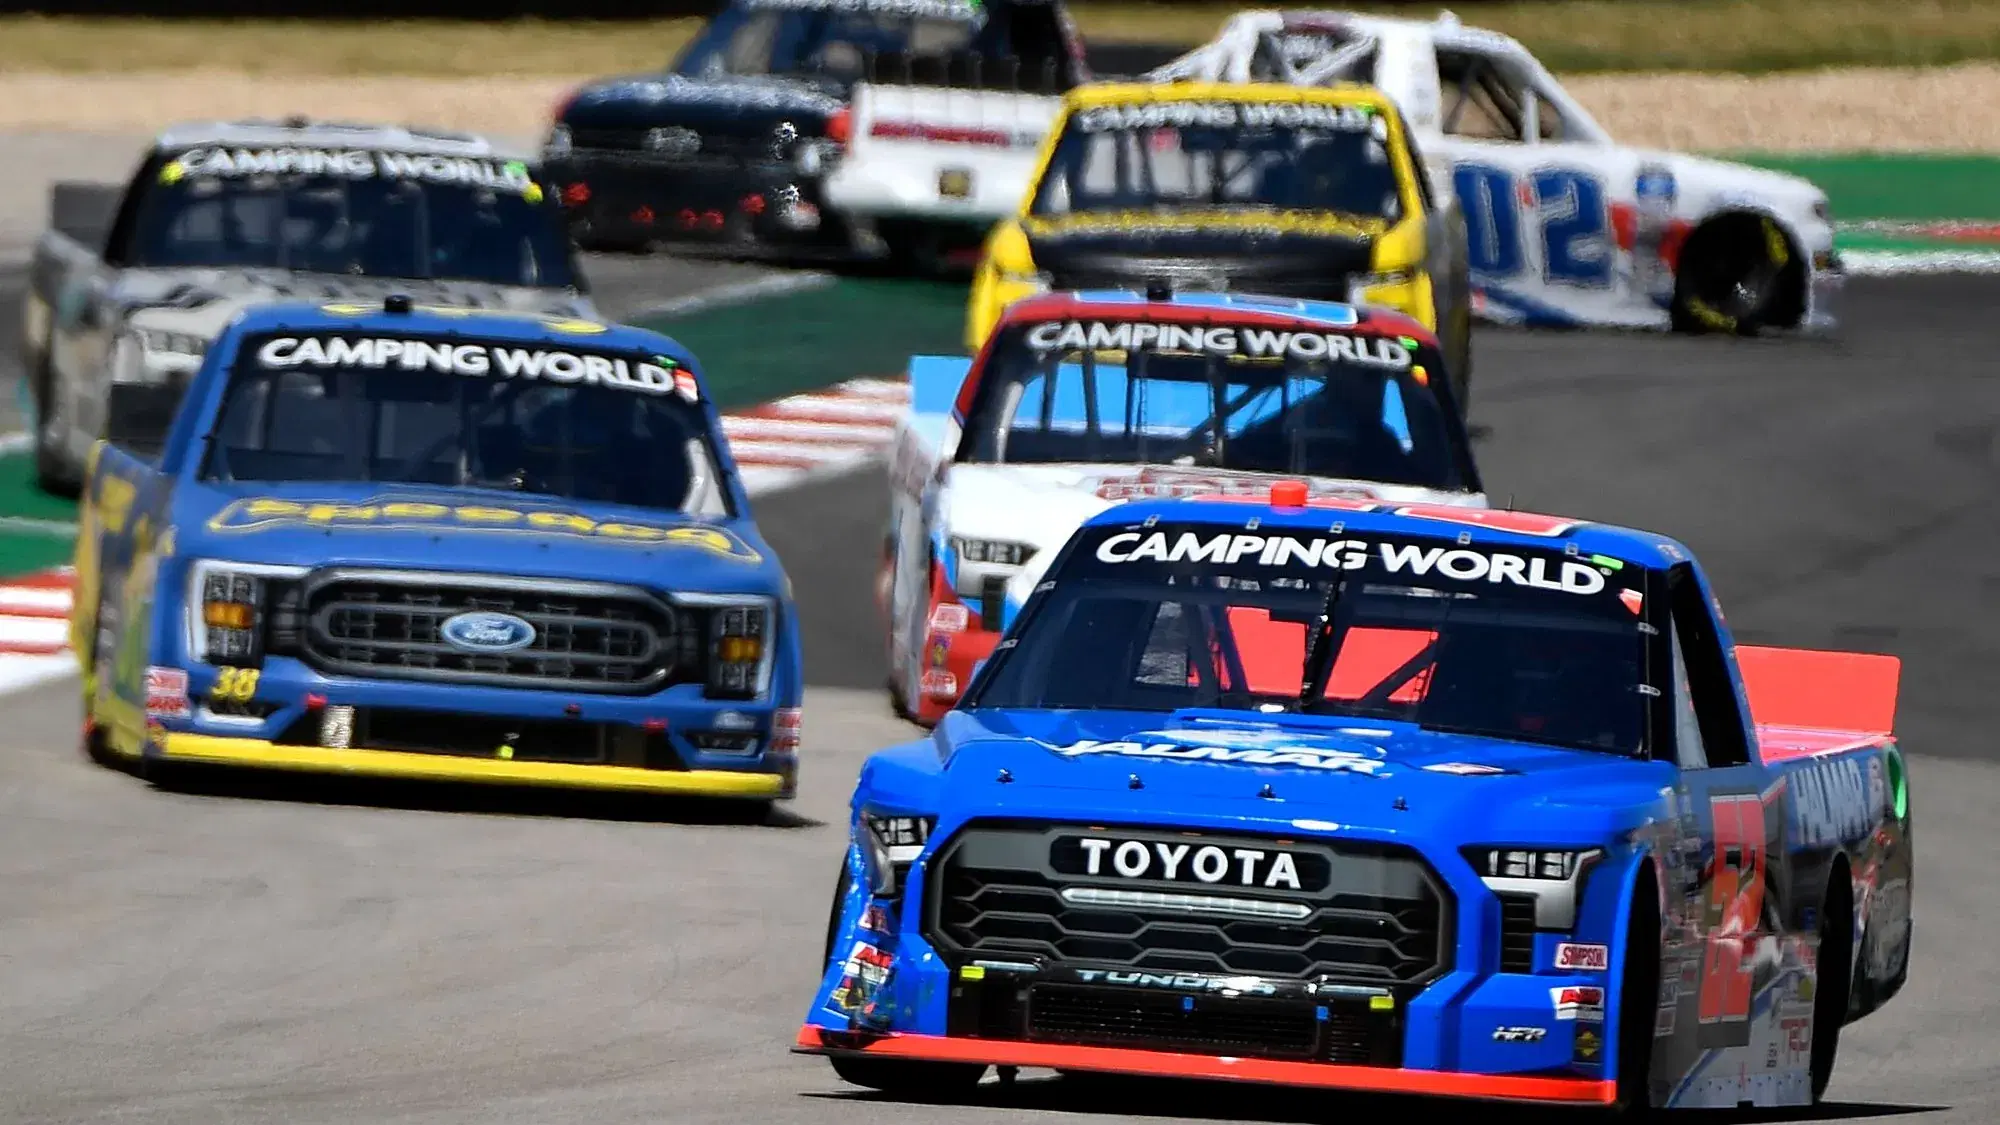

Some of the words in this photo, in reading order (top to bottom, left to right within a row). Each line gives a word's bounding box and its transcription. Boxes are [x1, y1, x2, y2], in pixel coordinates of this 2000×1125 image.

[177, 149, 375, 179] CAMPING
[257, 336, 490, 376] CAMPING
[494, 347, 675, 396] WORLD
[1028, 321, 1238, 354] CAMPING
[1243, 329, 1413, 370] WORLD
[1096, 531, 1368, 570] CAMPING
[1381, 547, 1606, 595] WORLD
[211, 664, 260, 701] 38
[1080, 838, 1301, 889] TOYOTA
